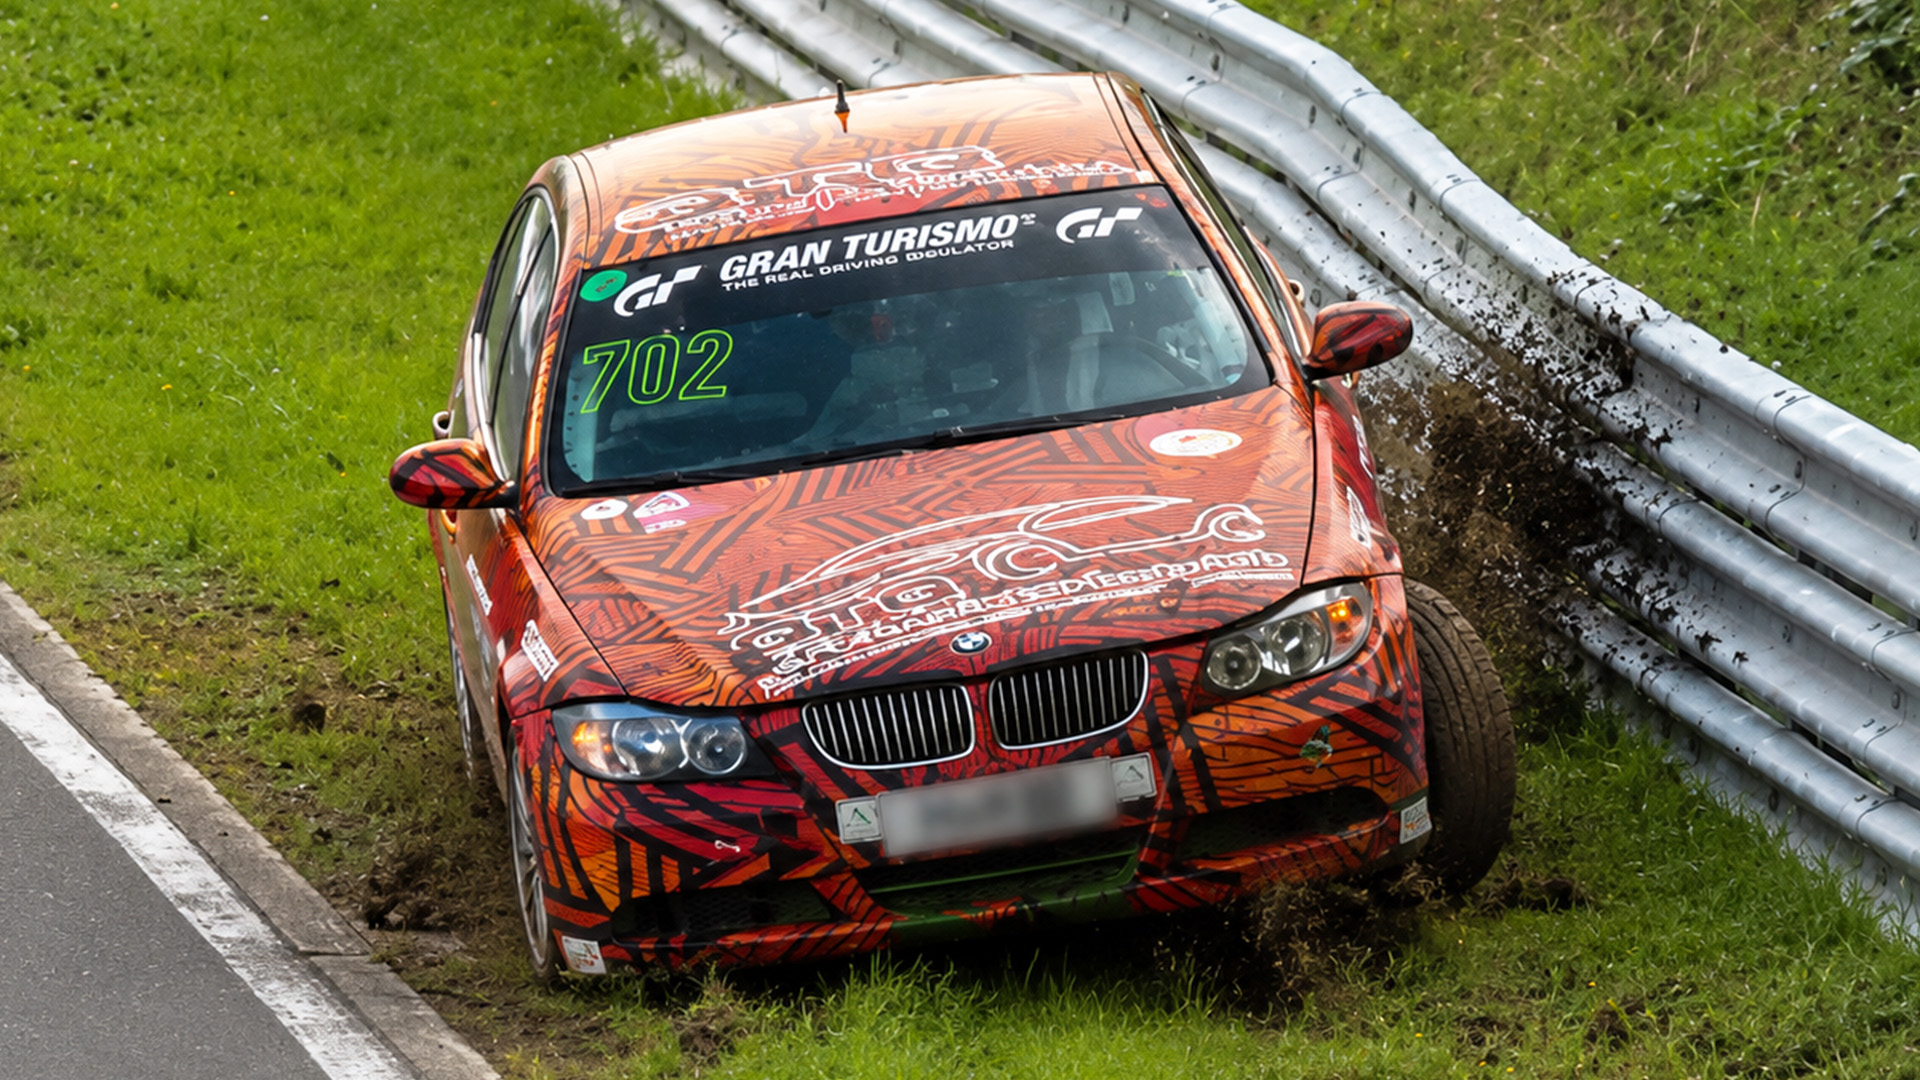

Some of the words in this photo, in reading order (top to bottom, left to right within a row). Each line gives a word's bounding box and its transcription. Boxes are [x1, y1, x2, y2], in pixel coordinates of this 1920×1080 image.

[719, 237, 831, 282] GRAN
[843, 213, 1021, 260] TURISMO
[721, 277, 760, 292] THE
[764, 269, 814, 285] REAL
[818, 254, 899, 276] DRIVING
[580, 329, 733, 414] 702
